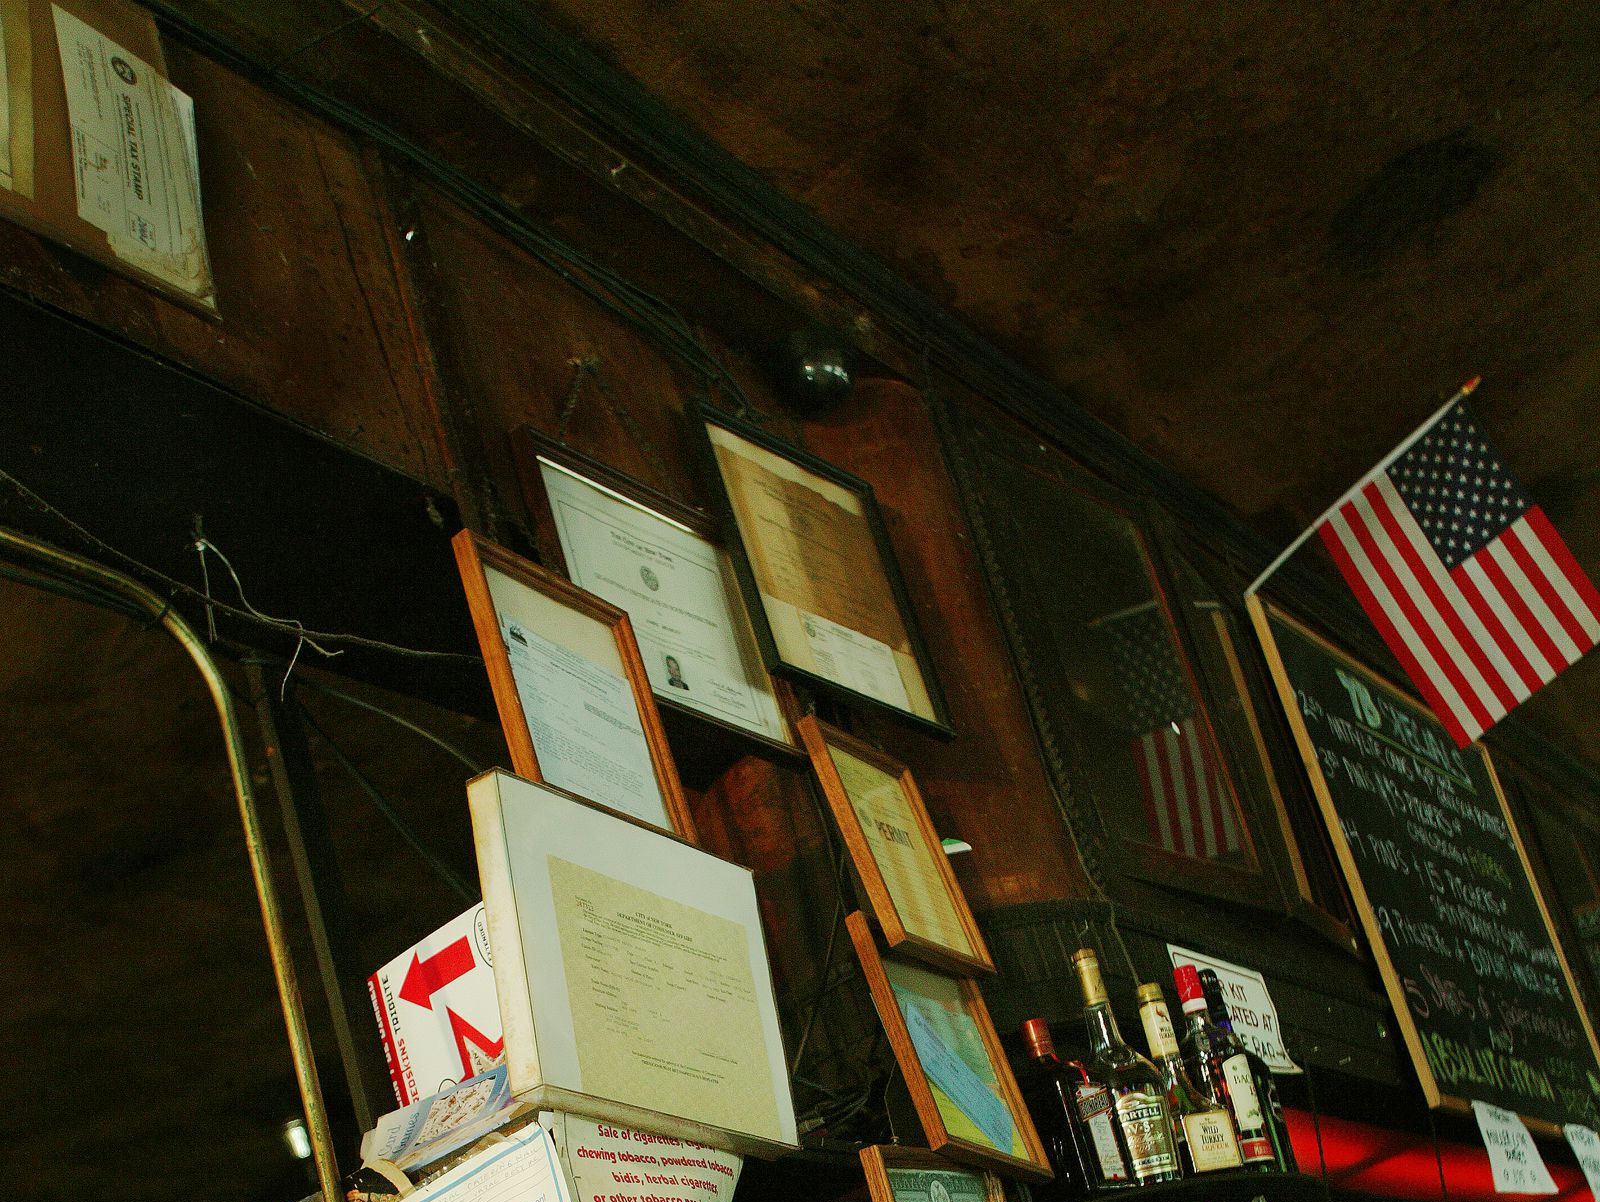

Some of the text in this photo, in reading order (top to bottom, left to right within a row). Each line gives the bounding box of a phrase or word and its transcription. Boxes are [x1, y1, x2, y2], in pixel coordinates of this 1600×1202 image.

[121, 93, 144, 201] SPECIAL TAX STAMP
[874, 820, 914, 850] PERMIT
[1228, 981, 1248, 1003] KIT
[1262, 1014, 1273, 1033] AT
[1121, 1106, 1160, 1121] ARTELL
[598, 1124, 618, 1138] Sale
[621, 1131, 630, 1141] of
[1201, 1133, 1225, 1144] TURKEY
[1202, 1125, 1219, 1134] WILD
[577, 1147, 734, 1180] chewing tobacco, powdered tobacco,
[612, 1172, 718, 1197] bidis, herbal cigarettes,
